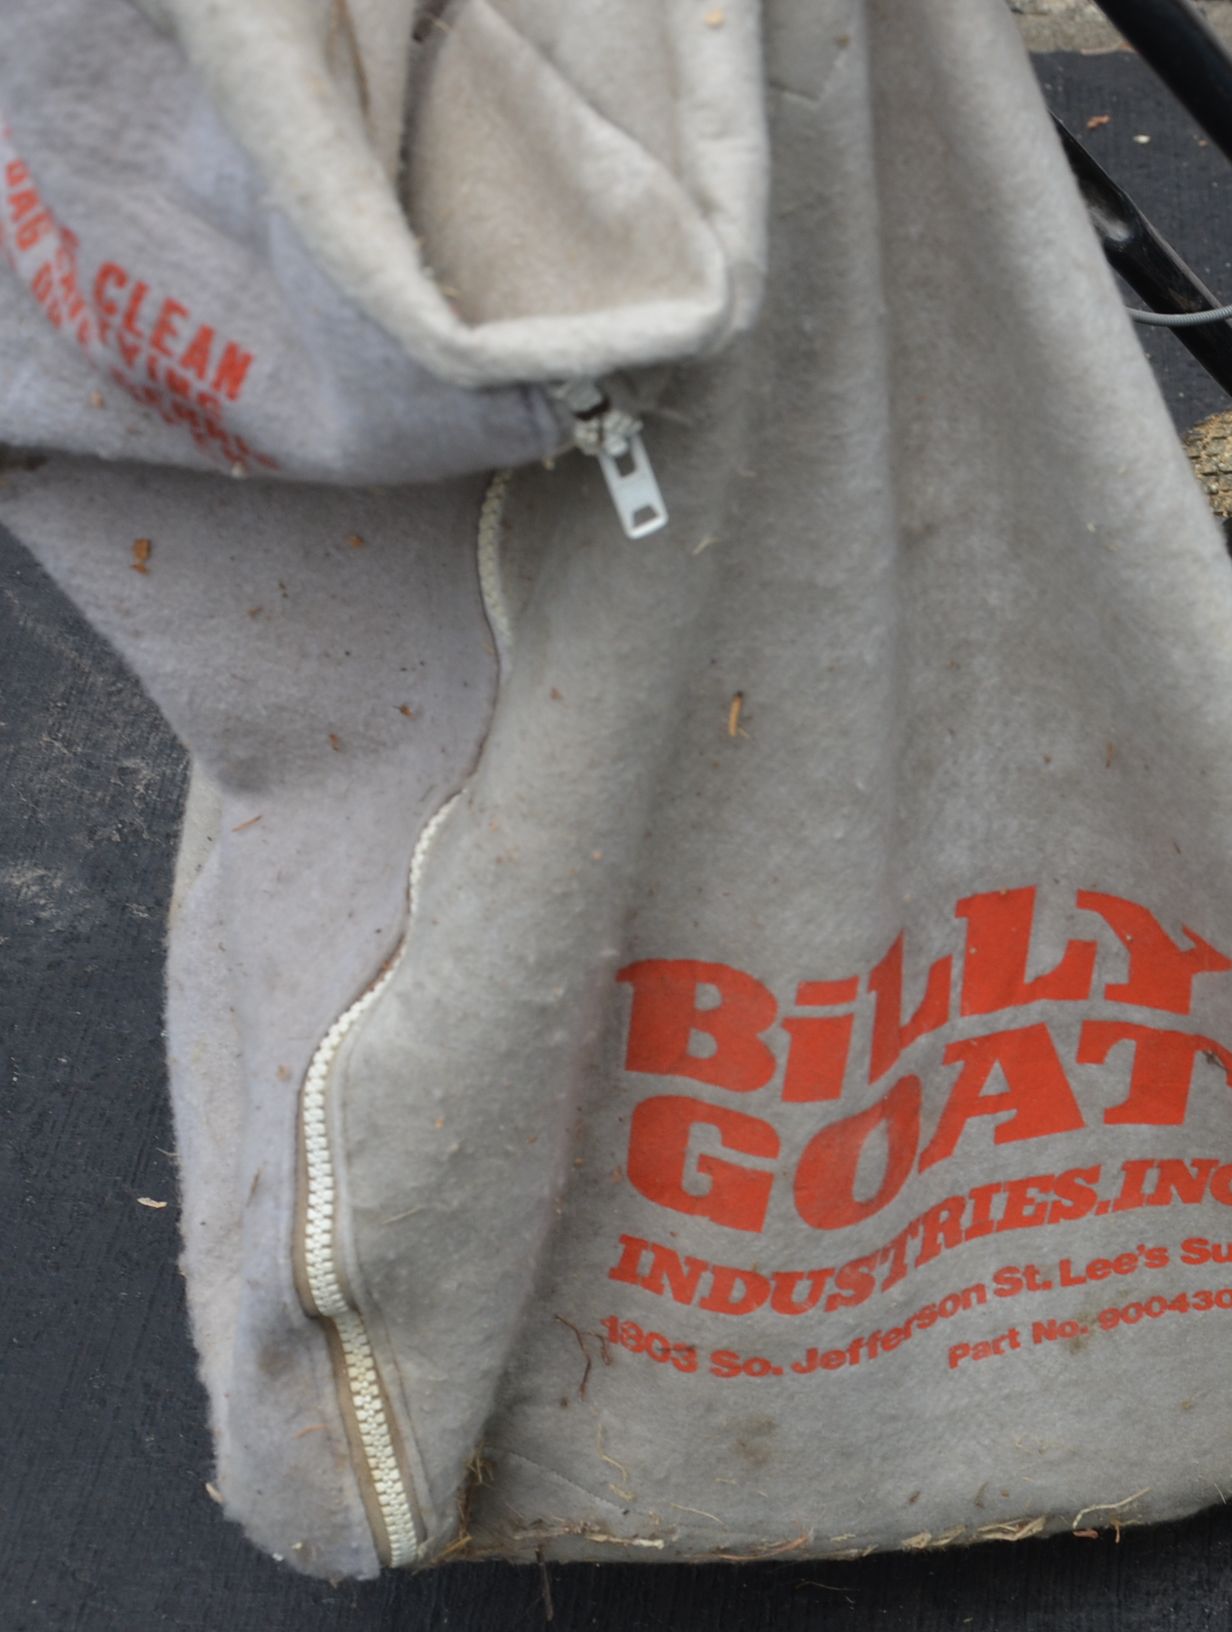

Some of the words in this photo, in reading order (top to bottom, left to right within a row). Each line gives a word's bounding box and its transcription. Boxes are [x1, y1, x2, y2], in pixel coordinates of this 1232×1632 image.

[93, 261, 255, 402] CLEAN
[601, 1314, 700, 1374] 1803
[709, 1348, 785, 1380] So.
[790, 1282, 989, 1375] Jefferson
[992, 1263, 1056, 1298] St.
[1058, 1242, 1171, 1288] Lee's
[947, 1326, 1023, 1370] Part
[1031, 1318, 1090, 1345] No.
